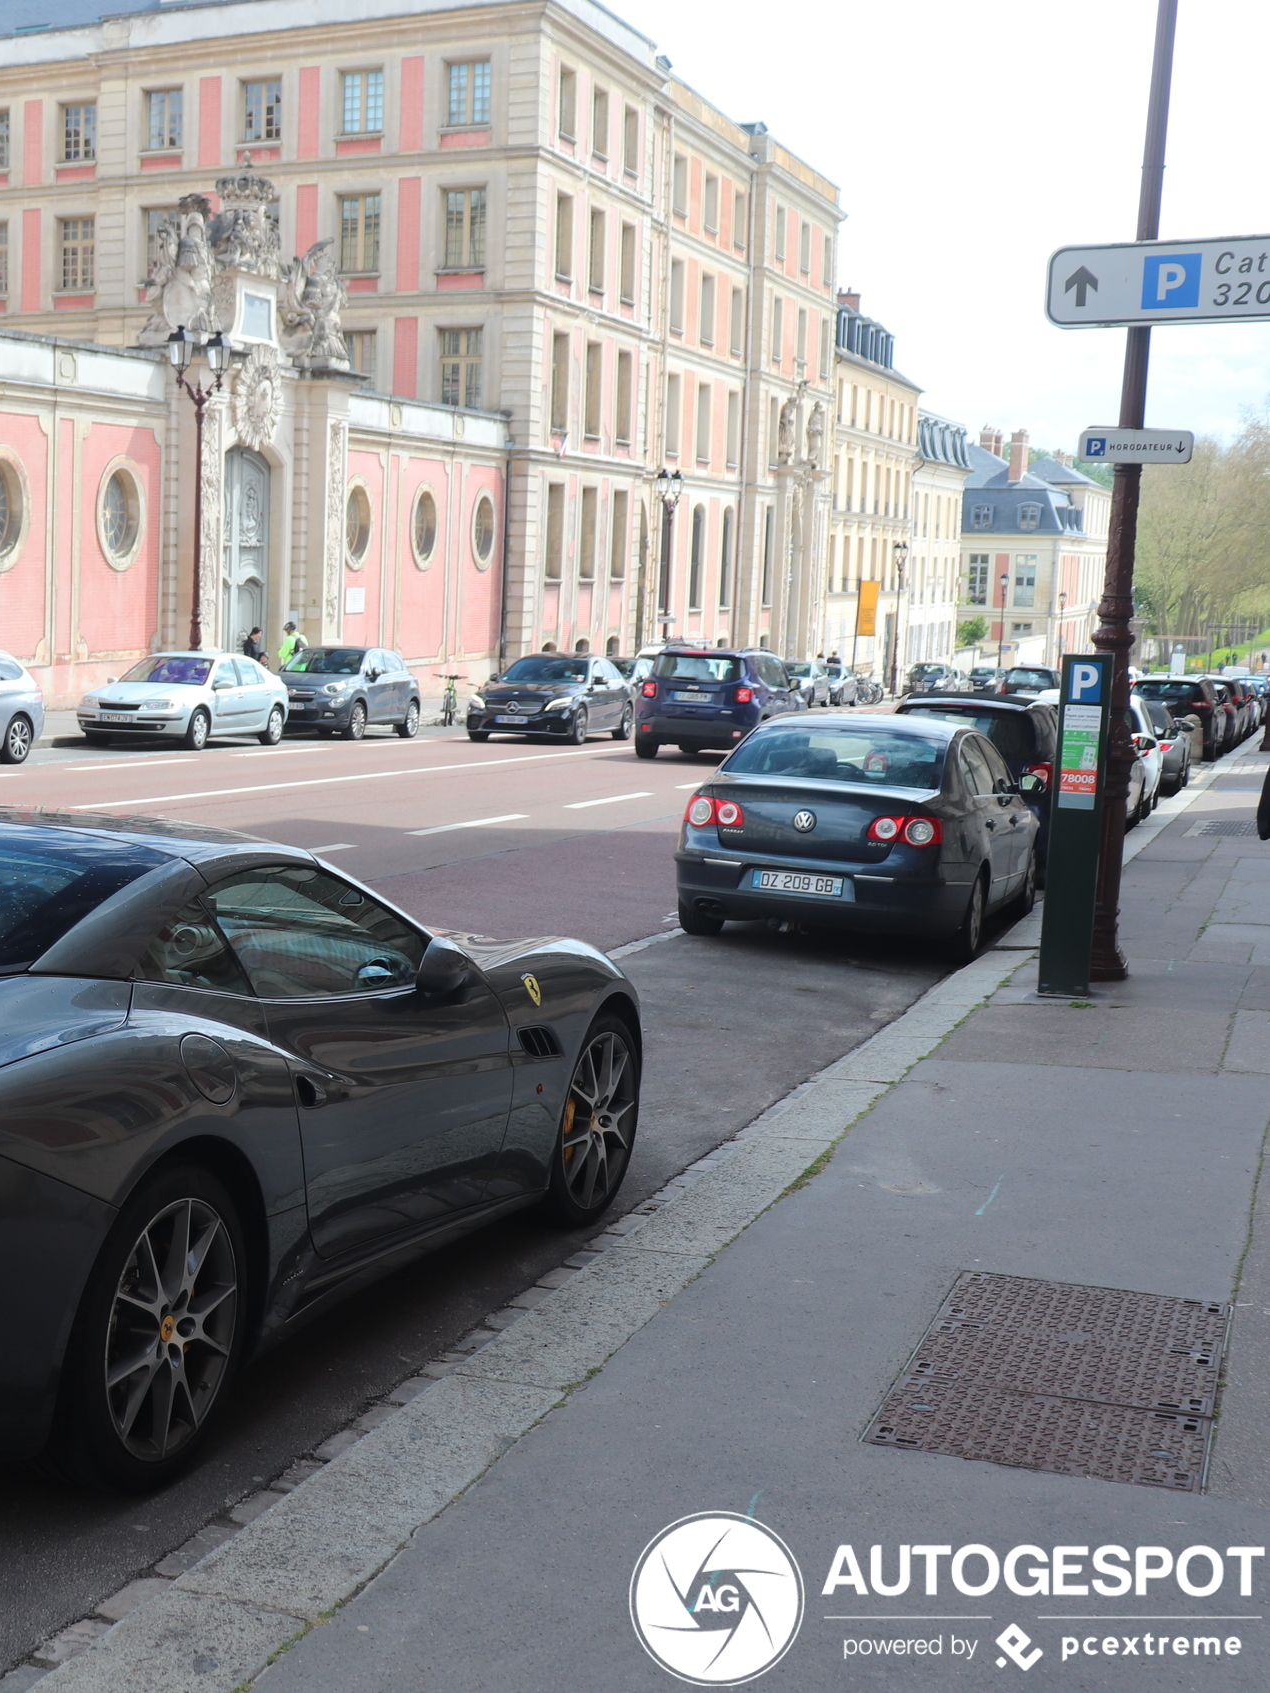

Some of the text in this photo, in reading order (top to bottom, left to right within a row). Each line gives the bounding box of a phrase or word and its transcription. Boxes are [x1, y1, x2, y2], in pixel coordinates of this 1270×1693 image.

[1215, 251, 1268, 274] Cat
[1157, 263, 1186, 301] P
[1213, 280, 1270, 306] 320
[1109, 443, 1172, 451] HORODATEUR
[1072, 664, 1099, 700] P
[1061, 773, 1095, 784] 78008
